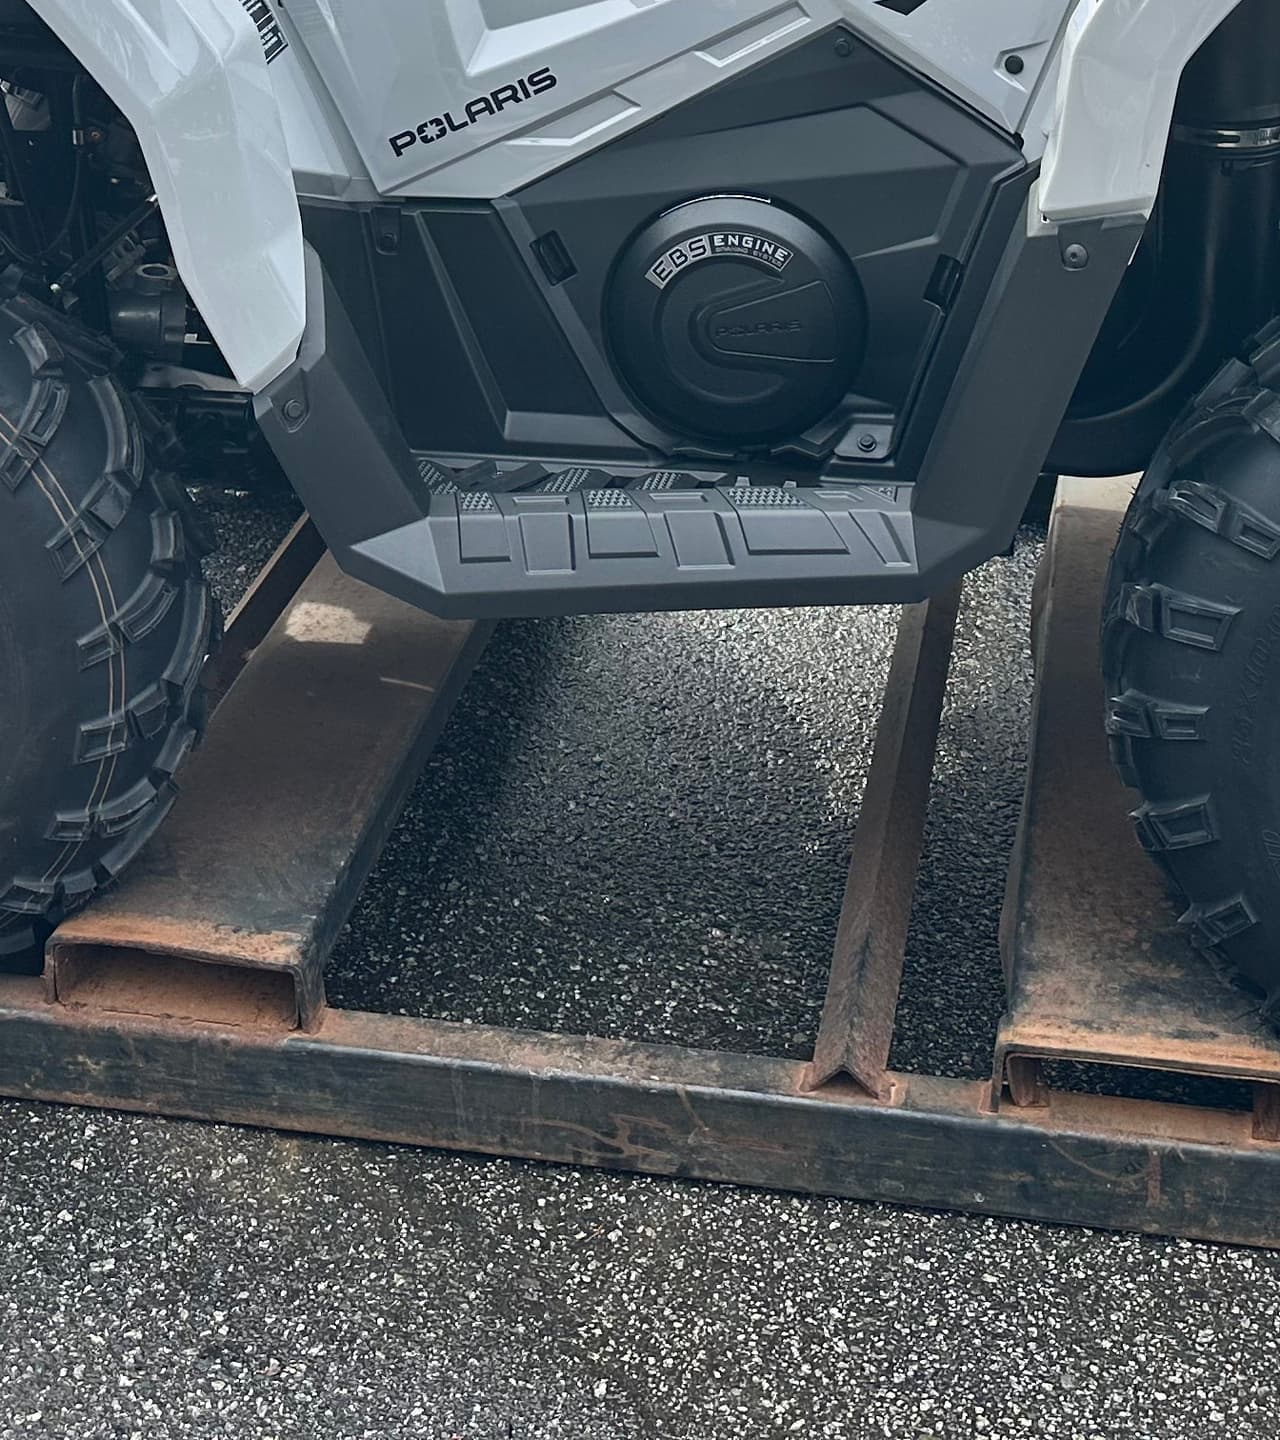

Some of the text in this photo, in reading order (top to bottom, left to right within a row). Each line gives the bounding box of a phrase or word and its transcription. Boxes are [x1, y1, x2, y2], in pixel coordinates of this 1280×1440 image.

[388, 66, 558, 157] POLARIS
[652, 234, 790, 282] EBS ENGINE
[715, 320, 801, 338] POLARIS
